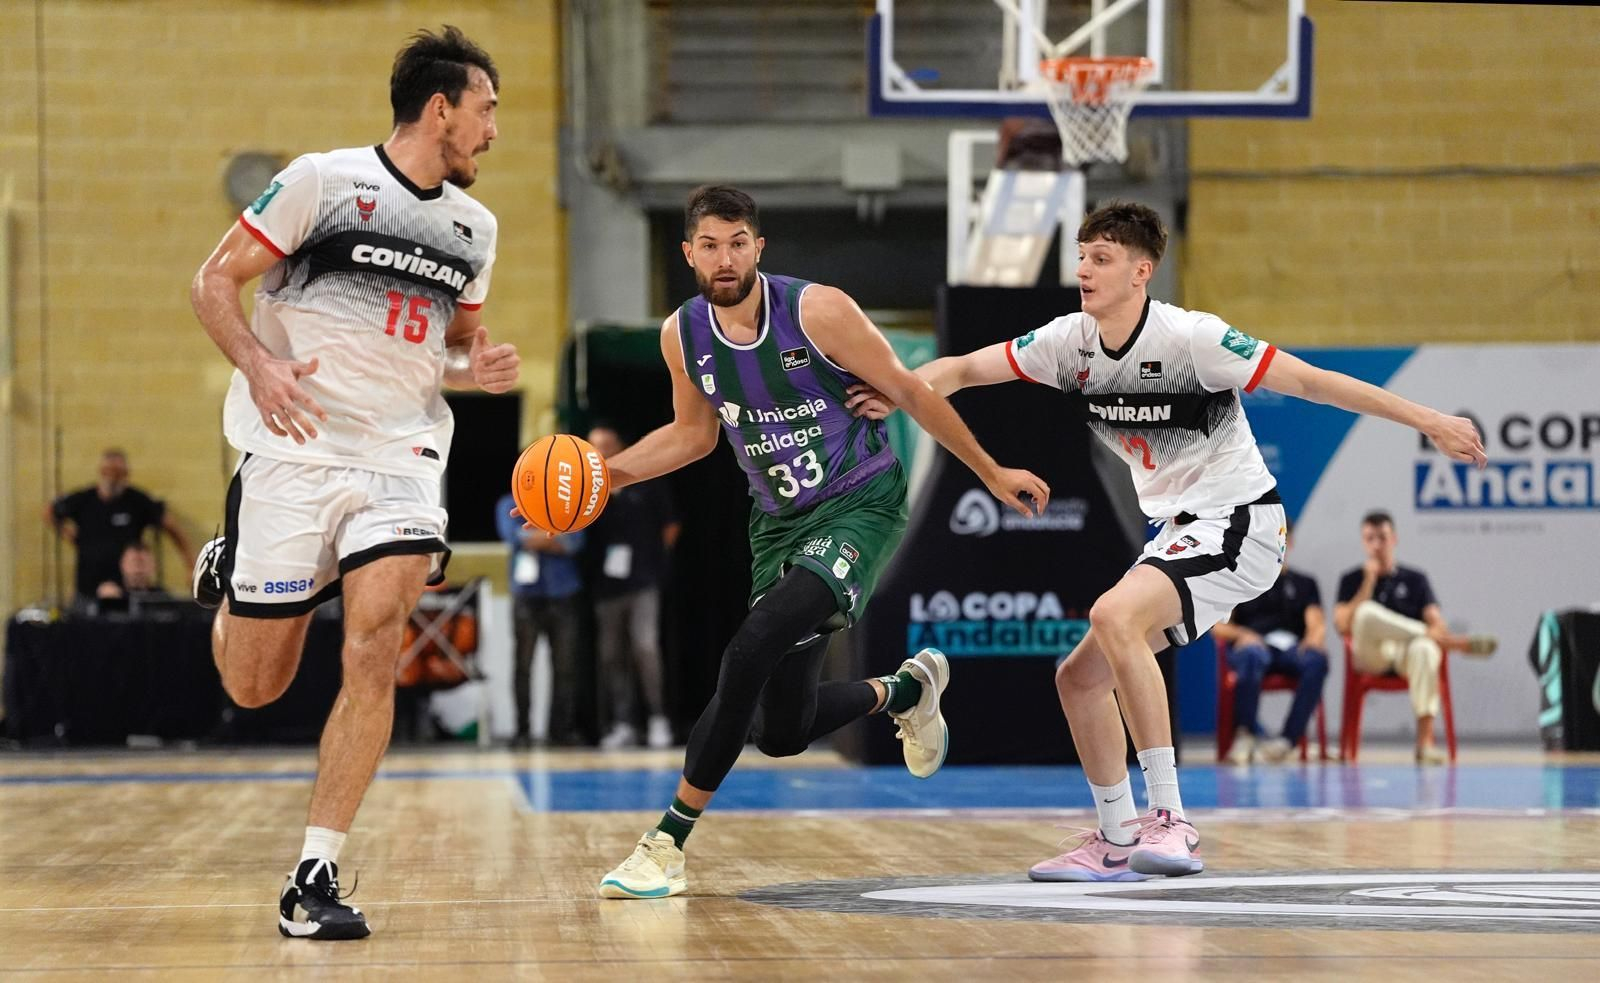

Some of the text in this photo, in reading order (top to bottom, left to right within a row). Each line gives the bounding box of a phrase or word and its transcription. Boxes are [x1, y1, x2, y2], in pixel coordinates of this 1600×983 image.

[353, 181, 380, 191] vive
[384, 290, 432, 344] 15
[746, 399, 828, 422] Unicaja
[557, 461, 572, 502] EVO
[583, 451, 604, 516] Wilson
[768, 449, 824, 498] 33
[236, 579, 307, 593] vive asisa
[962, 591, 1064, 620] COPA
